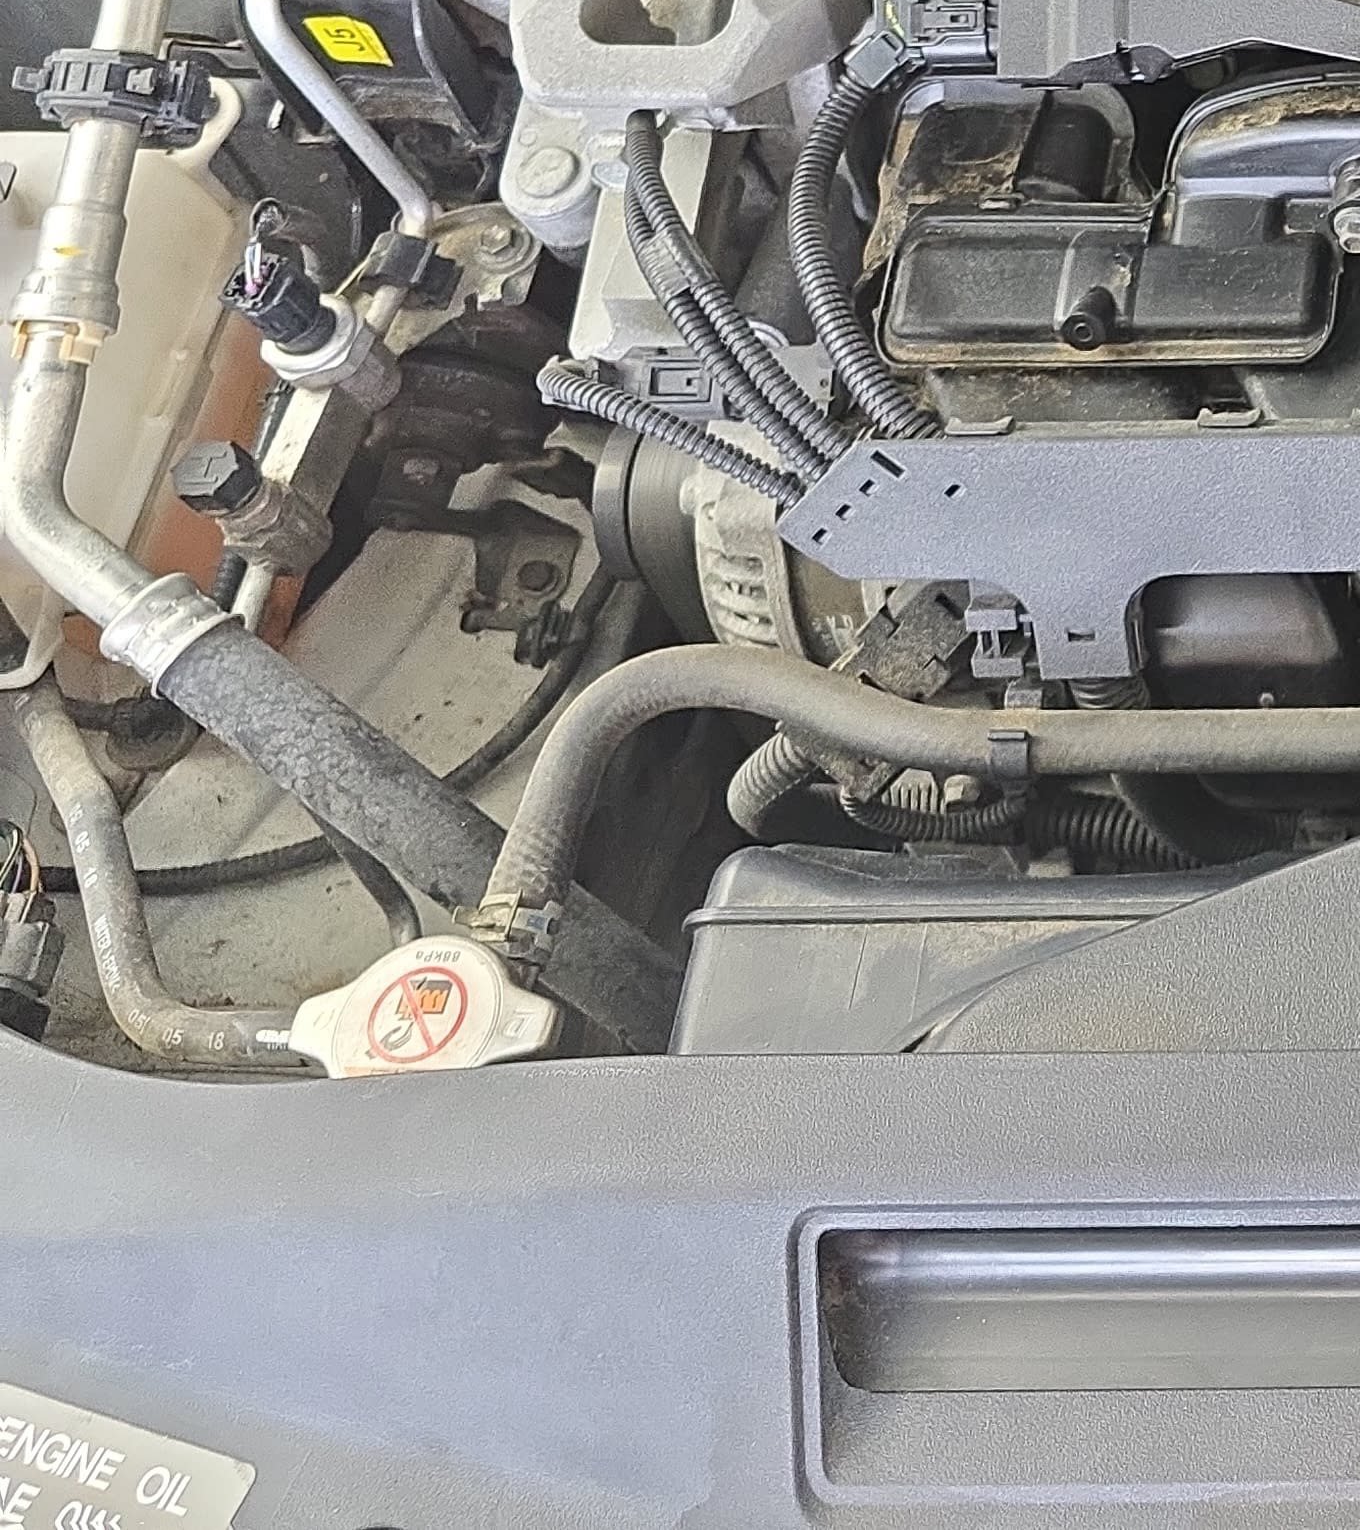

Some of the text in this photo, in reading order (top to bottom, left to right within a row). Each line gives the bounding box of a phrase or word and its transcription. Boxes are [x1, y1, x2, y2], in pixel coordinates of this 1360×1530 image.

[415, 949, 461, 963] 88kPa
[0, 1415, 193, 1518] ENGINE OIL
